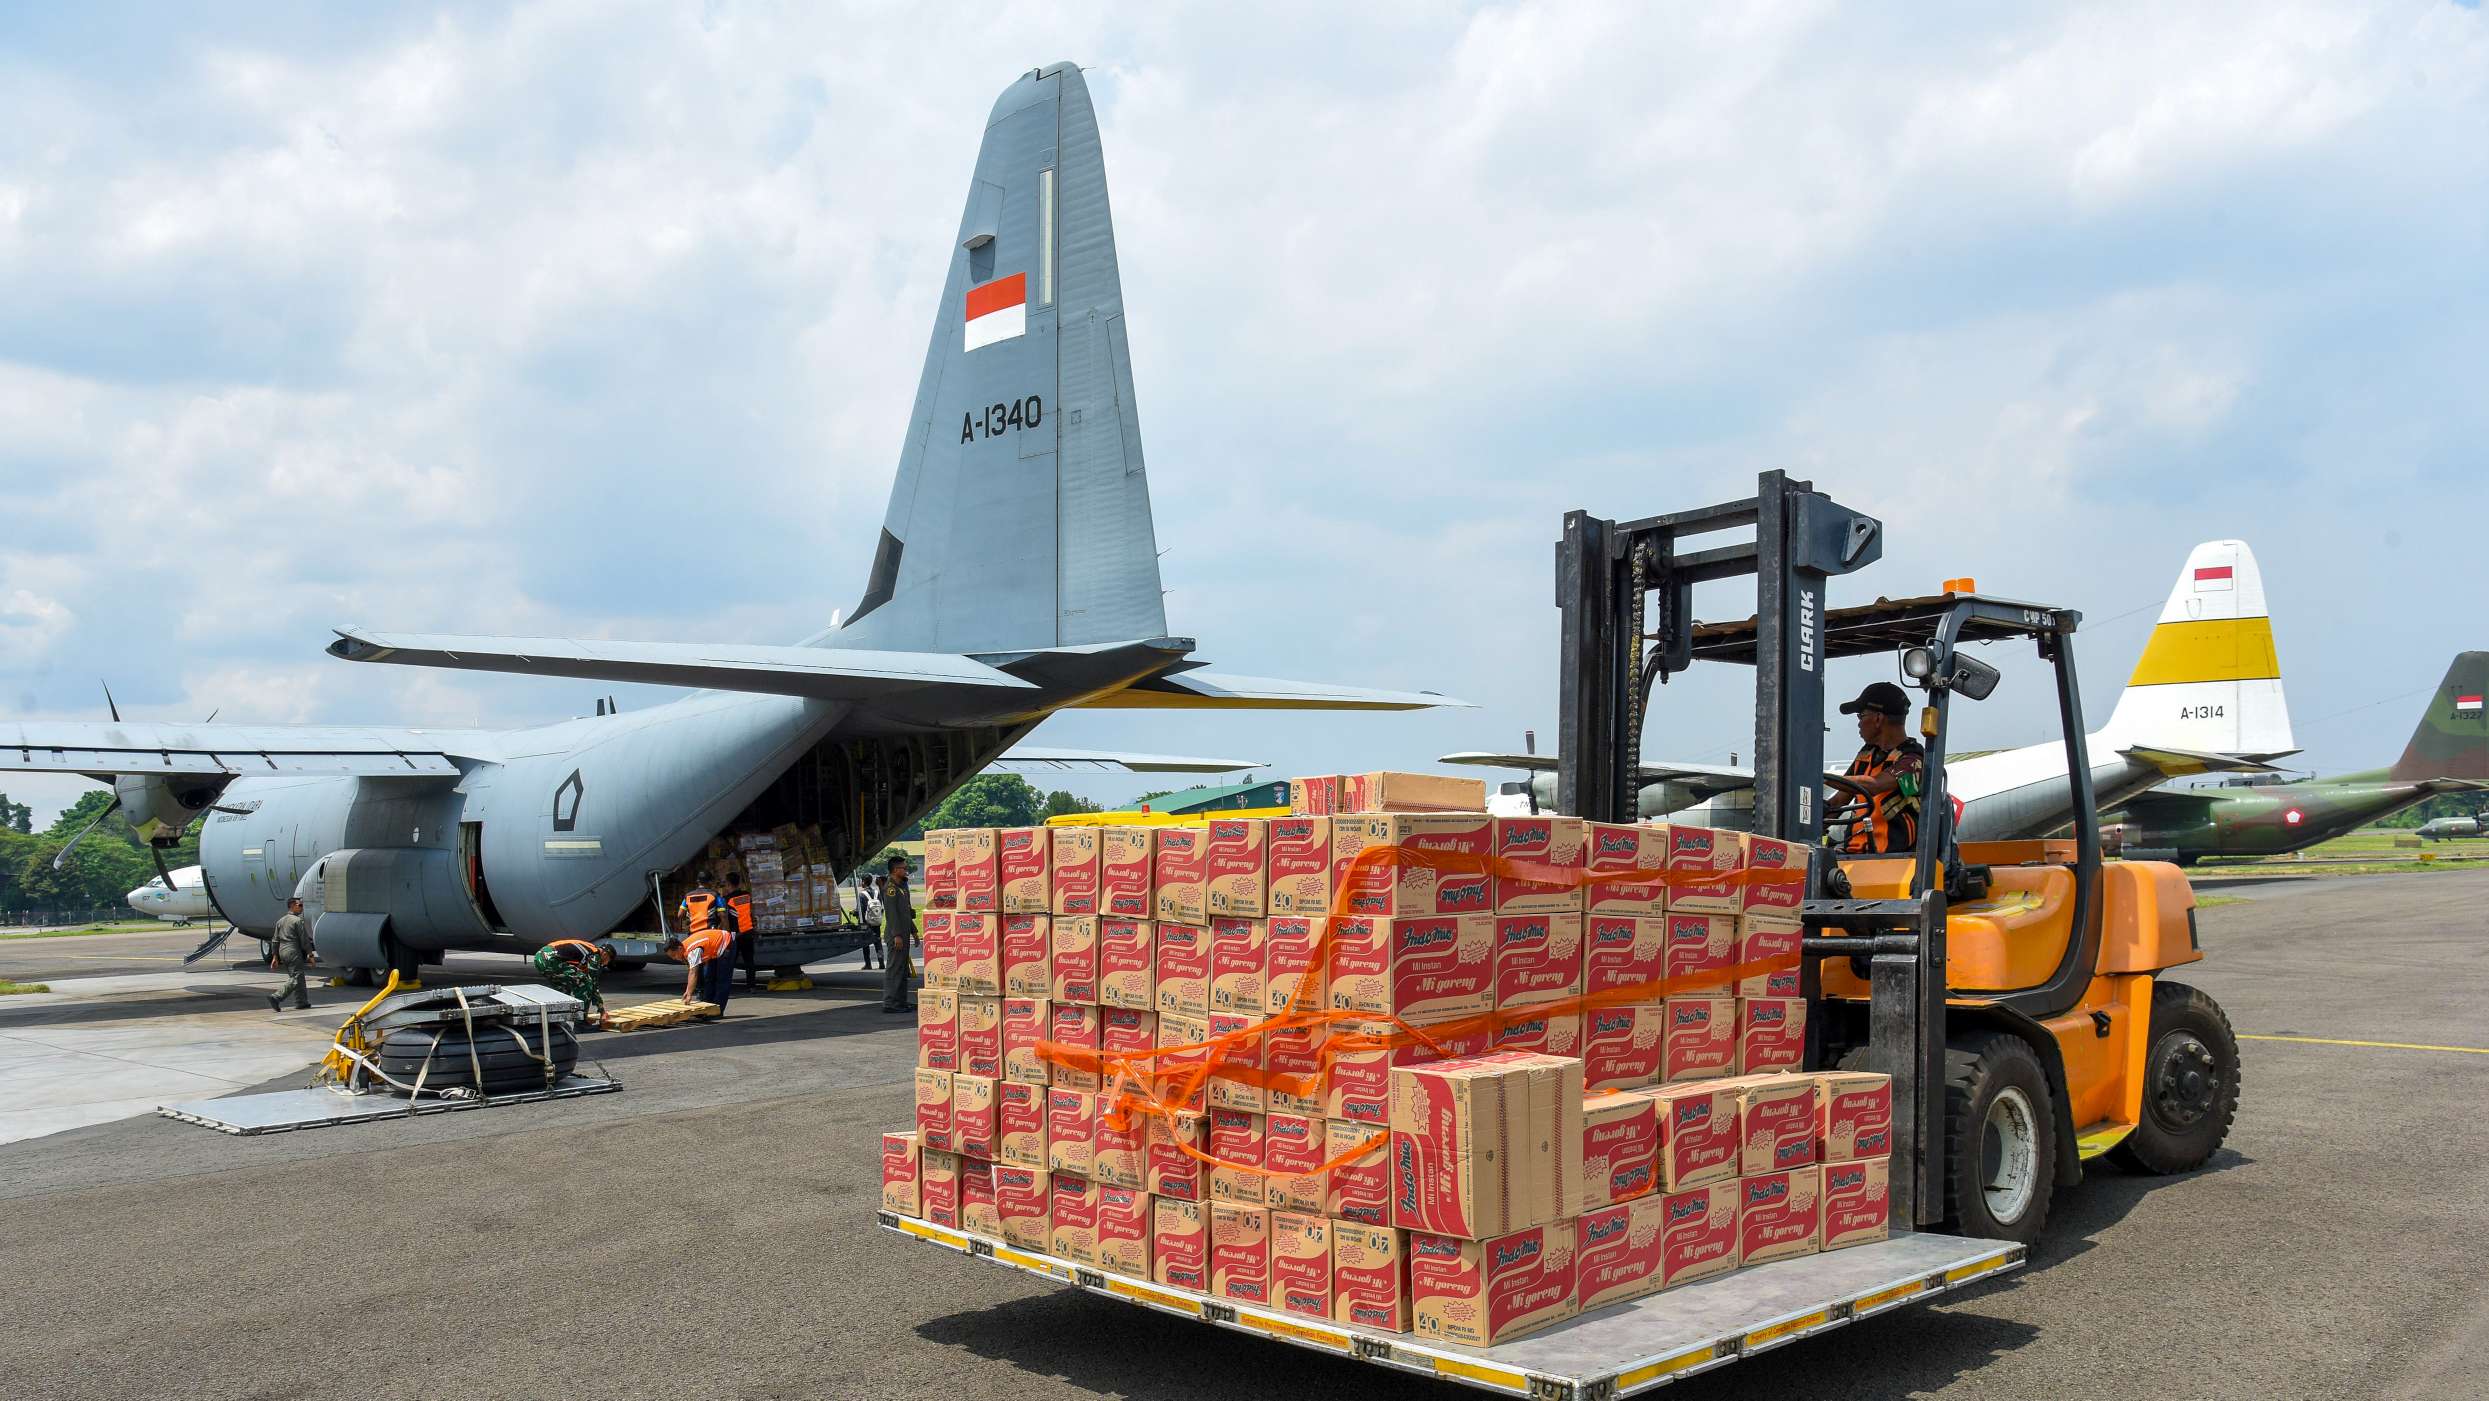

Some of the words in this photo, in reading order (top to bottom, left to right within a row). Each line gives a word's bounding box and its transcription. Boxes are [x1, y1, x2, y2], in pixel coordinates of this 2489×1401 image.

[961, 395, 1041, 444] A-1340
[1800, 589, 1814, 672] CLARK
[2180, 705, 2225, 719] A-1314
[1277, 823, 1311, 837] Indomie
[1506, 825, 1547, 844] Indomie
[1418, 837, 1457, 852] goreng
[1599, 833, 1637, 852] Indomie
[1676, 833, 1711, 852] Indomie
[1755, 844, 1786, 862] Indomie
[1277, 855, 1290, 867] Mi
[1289, 857, 1320, 870] goreng
[1441, 883, 1485, 902] Indomie
[1757, 886, 1770, 898] Mi
[1769, 890, 1793, 904] goreng
[1275, 923, 1309, 936] Indomie
[1336, 922, 1370, 936] Indomie
[1402, 927, 1453, 948] Indomie
[1505, 924, 1546, 943] Indomie
[1597, 924, 1633, 943] Indomie
[1674, 921, 1706, 939] Indomie
[1335, 956, 1350, 967] Mi
[1349, 958, 1381, 972] goreng
[1420, 961, 1442, 970] Instan
[1416, 977, 1435, 993] Mi
[1436, 976, 1477, 993] goreng
[1514, 971, 1531, 985] Mi
[1530, 972, 1565, 986] goreng
[1602, 970, 1617, 982] Mi
[1616, 971, 1648, 985] goreng
[1770, 975, 1796, 991] Indomie
[1596, 1014, 1632, 1032] Indomie
[1675, 1007, 1708, 1025] Indomie
[1753, 1007, 1784, 1023] Indomie
[1682, 1050, 1695, 1063] Mi
[1695, 1050, 1723, 1064] goreng
[1759, 1047, 1772, 1059] Mi
[1771, 1049, 1795, 1063] goreng
[1335, 1064, 1366, 1079] goreng
[1601, 1059, 1616, 1072] Mi
[1615, 1060, 1646, 1074] goreng
[1343, 1100, 1382, 1117] Indomie
[1760, 1104, 1790, 1118] goreng
[1842, 1096, 1868, 1109] goreng
[1679, 1104, 1710, 1124] Indomie
[1273, 1120, 1306, 1135] Indomie
[1592, 1124, 1626, 1143] goreng
[1626, 1124, 1640, 1140] Mi
[1440, 1107, 1454, 1173] goreng
[1856, 1132, 1887, 1150] Indomie
[1687, 1150, 1700, 1164] Mi
[1699, 1146, 1725, 1163] goreng
[1776, 1140, 1809, 1160] Indomie
[1285, 1156, 1316, 1171] goreng
[1333, 1167, 1365, 1182] goreng
[1399, 1140, 1417, 1214] Indomie
[1427, 1162, 1436, 1192] Instan
[1614, 1164, 1650, 1188] Indomie
[1831, 1172, 1864, 1188] Indomie
[1439, 1171, 1453, 1203] Mi
[1749, 1182, 1786, 1202] Indomie
[1343, 1204, 1380, 1220] Indomie
[1671, 1199, 1707, 1220] Indomie
[1839, 1213, 1852, 1226] Mi
[1851, 1211, 1878, 1226] goreng
[1586, 1216, 1626, 1242] Indomie
[1758, 1225, 1774, 1240] Mi
[1773, 1223, 1805, 1240] goreng
[1418, 1241, 1457, 1256] Indomie
[1496, 1239, 1540, 1266] Indomie
[1679, 1245, 1695, 1259] Mi
[1694, 1240, 1724, 1259] goreng
[1278, 1259, 1307, 1276] goreng
[1596, 1266, 1613, 1283] Mi
[1612, 1260, 1646, 1281] goreng
[1341, 1269, 1372, 1286] goreng
[1418, 1275, 1435, 1287] Mi
[1434, 1279, 1472, 1295] goreng
[1511, 1276, 1529, 1288] Instan
[1288, 1294, 1322, 1312] Indomie
[1507, 1293, 1524, 1311] Mi
[1524, 1285, 1562, 1308] goreng
[1354, 1306, 1389, 1323] Indomie
